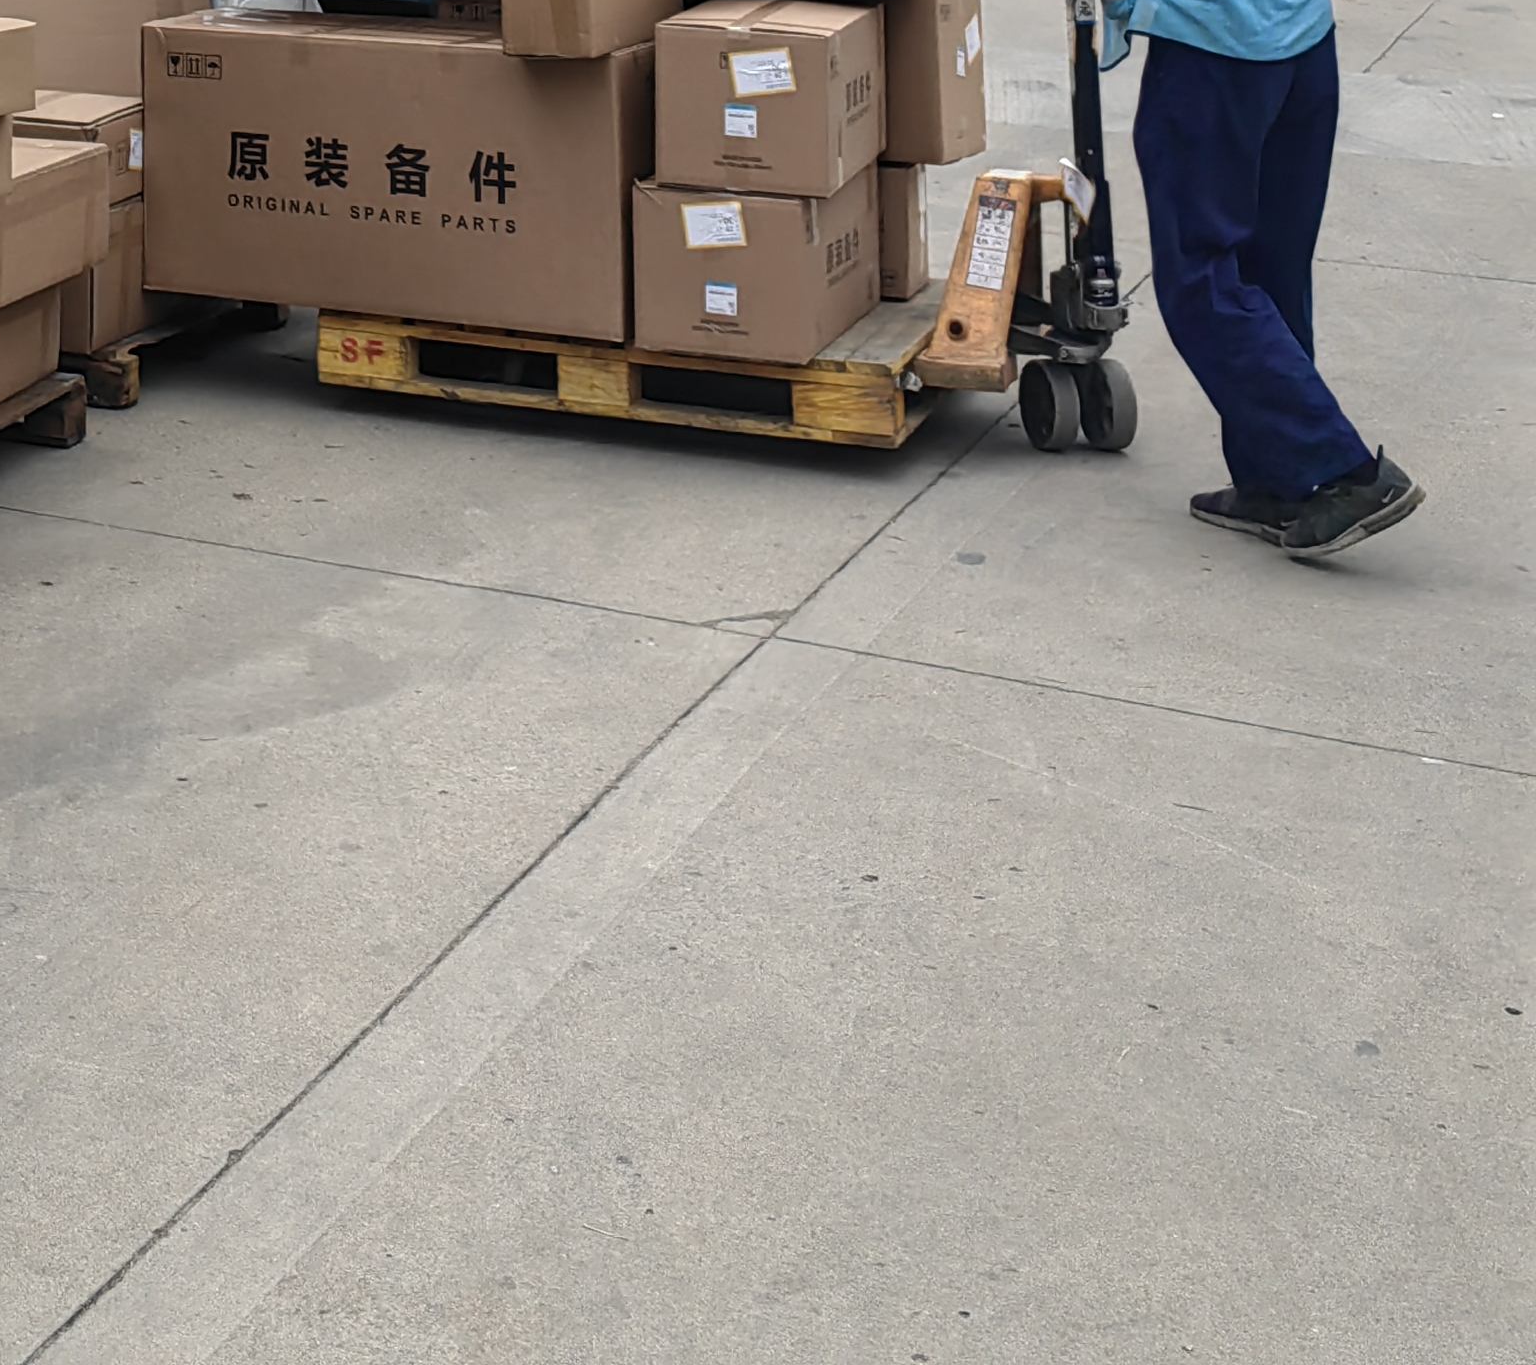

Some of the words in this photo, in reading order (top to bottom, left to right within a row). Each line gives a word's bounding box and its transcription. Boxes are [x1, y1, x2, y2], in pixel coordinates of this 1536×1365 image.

[227, 131, 517, 205] 原装备件
[228, 193, 330, 216] ORIGINAL
[350, 205, 422, 225] SPARE
[441, 214, 517, 234] PARTS
[341, 337, 385, 366] SF
